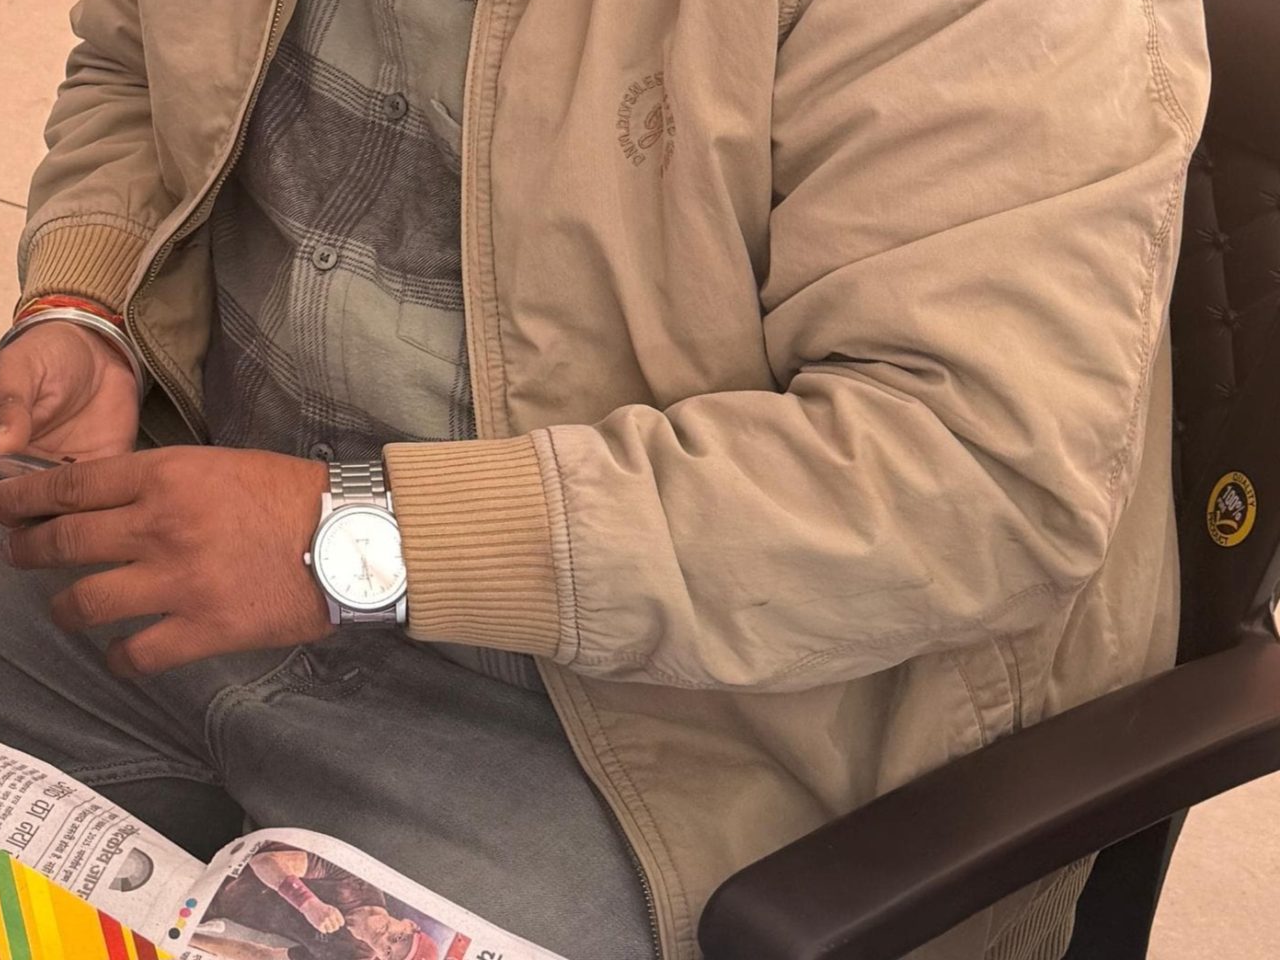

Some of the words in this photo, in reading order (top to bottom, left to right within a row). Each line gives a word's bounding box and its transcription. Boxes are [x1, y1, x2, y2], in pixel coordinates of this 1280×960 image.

[1222, 486, 1245, 521] 100%
[26, 800, 55, 822] का
[6, 822, 40, 851] नया
[55, 840, 69, 853] होता
